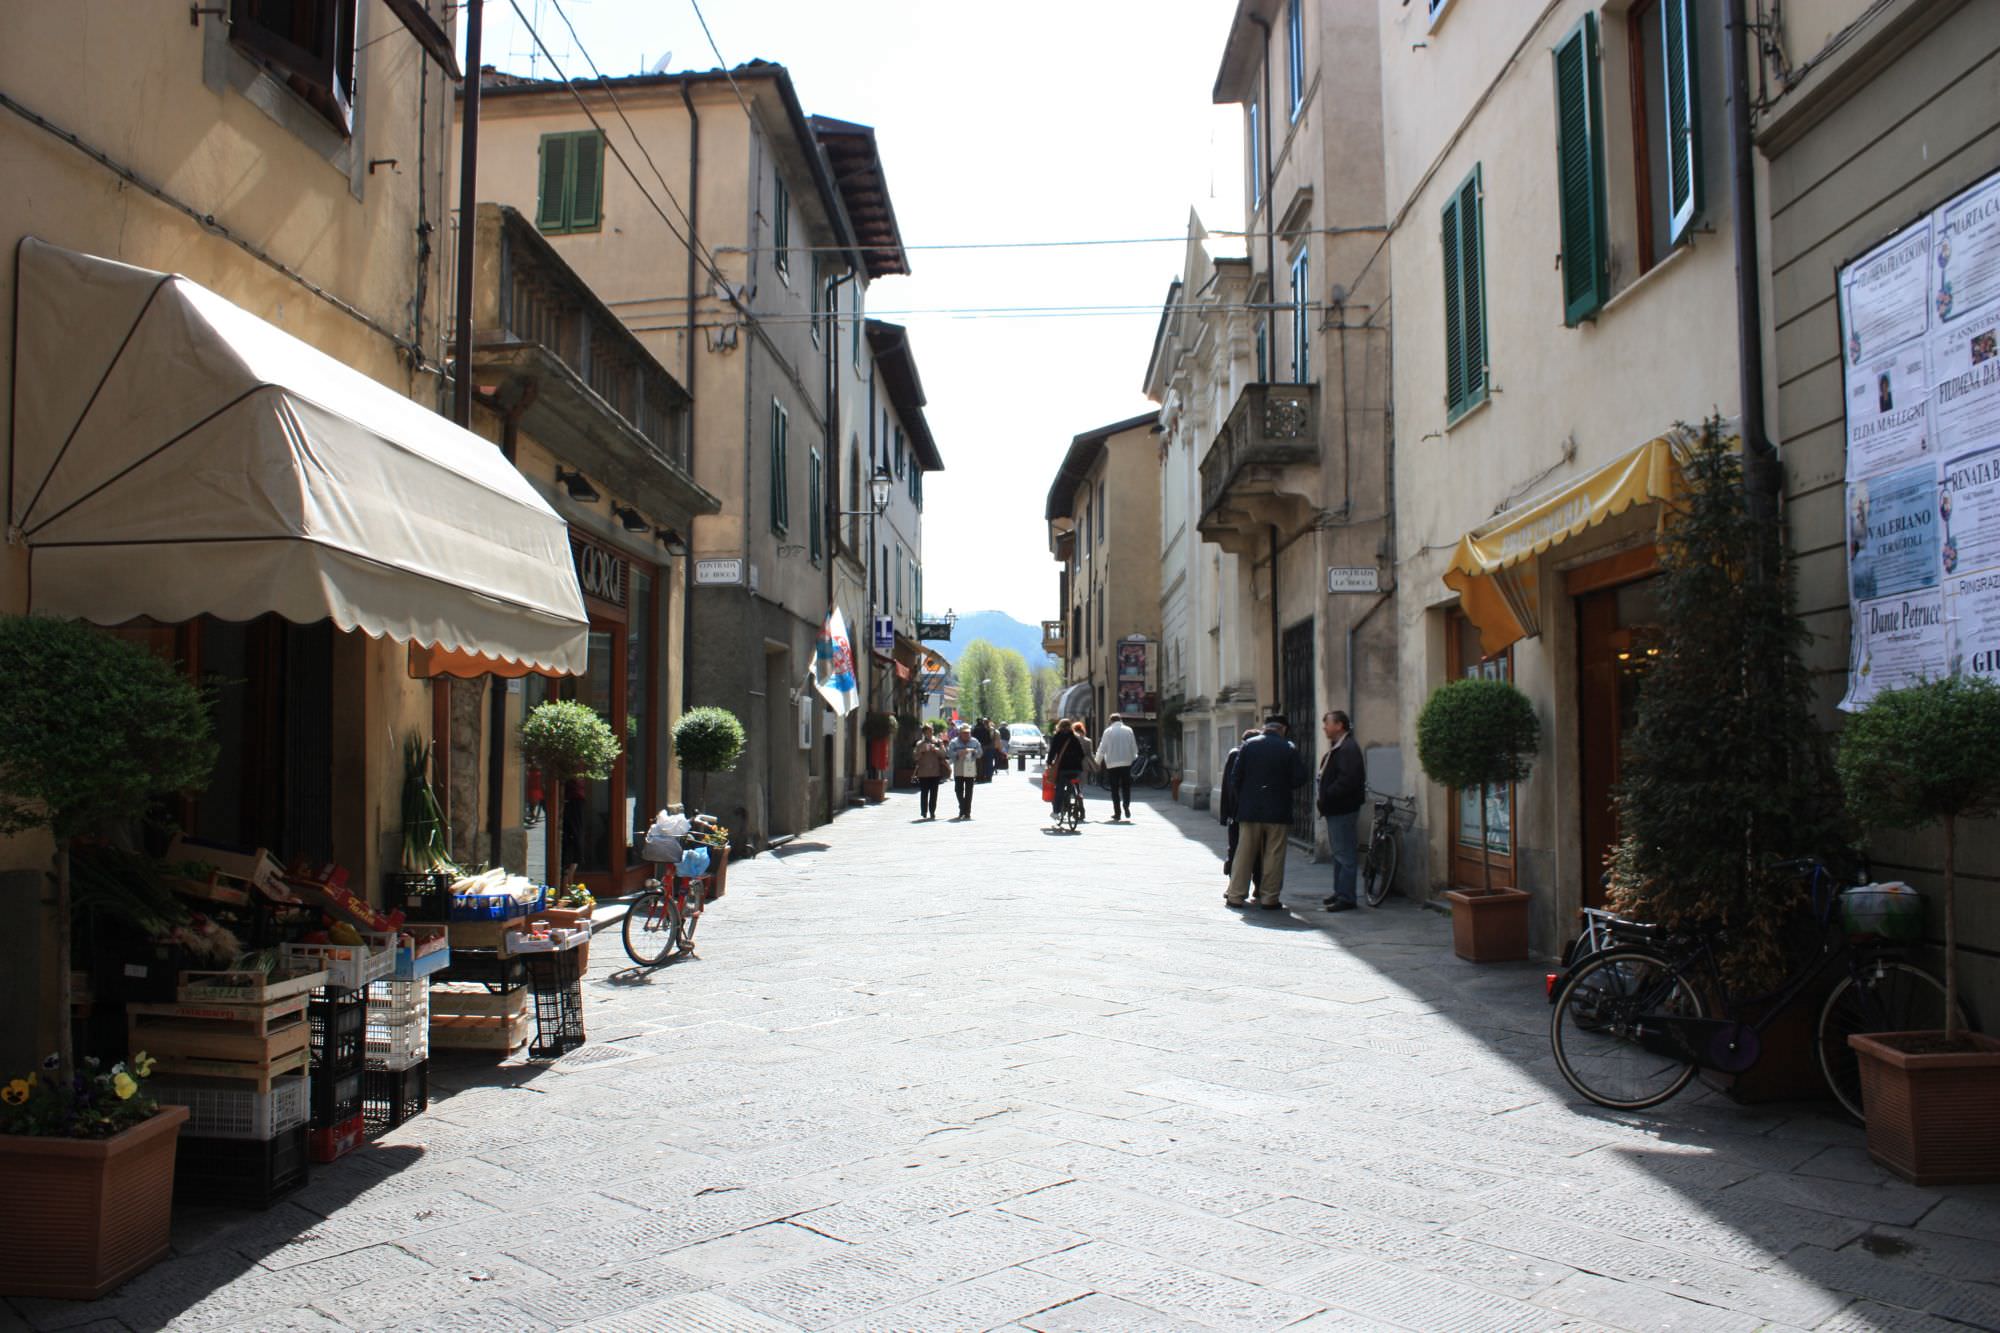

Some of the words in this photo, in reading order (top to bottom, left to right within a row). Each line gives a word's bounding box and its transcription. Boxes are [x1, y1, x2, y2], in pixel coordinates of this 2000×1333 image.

[1952, 463, 1991, 493] RENATA
[1868, 509, 1932, 540] VALERIANO
[1872, 607, 1899, 635] Dante
